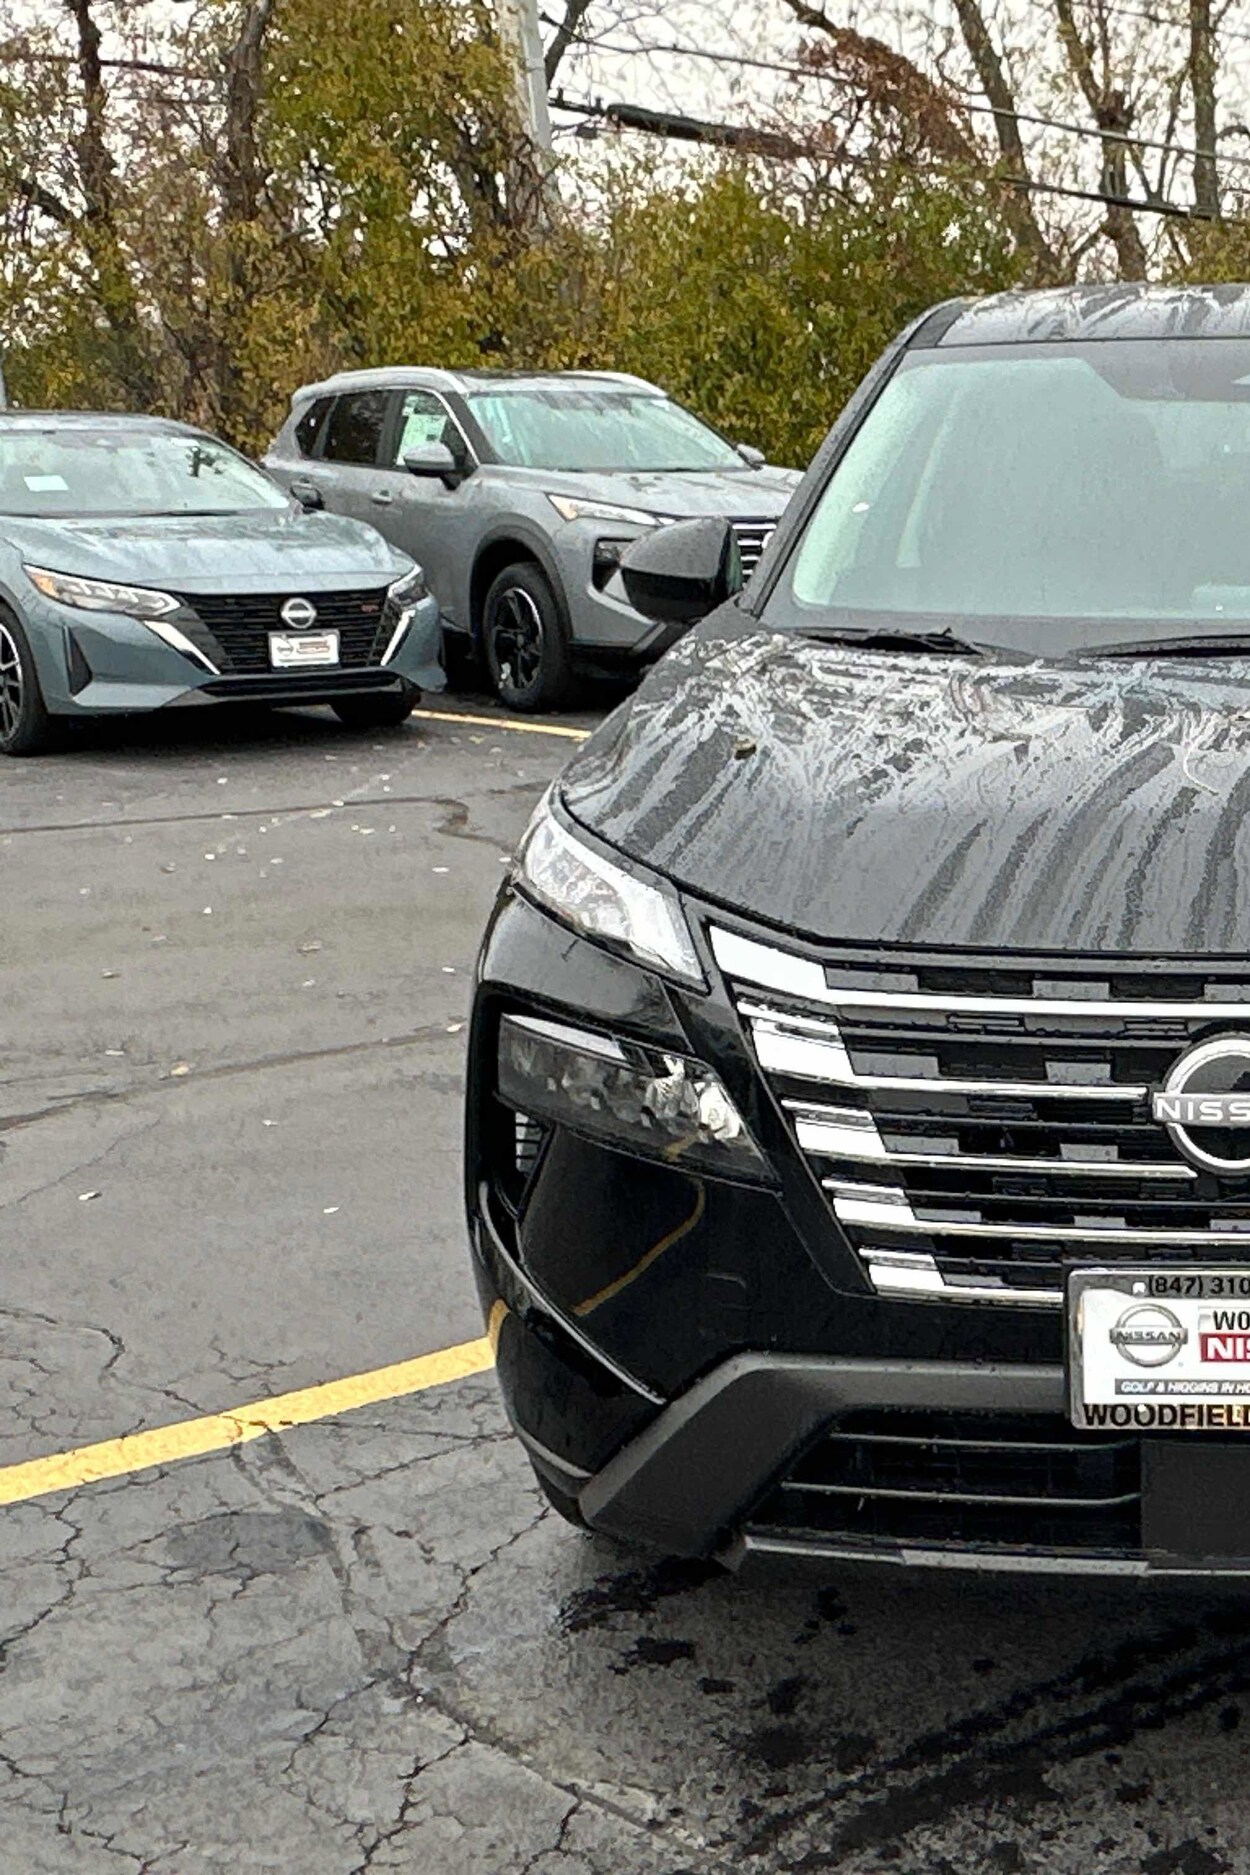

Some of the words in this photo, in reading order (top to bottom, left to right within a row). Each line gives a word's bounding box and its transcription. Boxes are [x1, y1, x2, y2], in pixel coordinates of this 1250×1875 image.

[1149, 1276, 1204, 1297] (847)
[1116, 1330, 1182, 1342] NISSAN
[1120, 1380, 1154, 1393] GOLF
[1167, 1381, 1218, 1394] HIGGINS
[1220, 1382, 1234, 1394] IN
